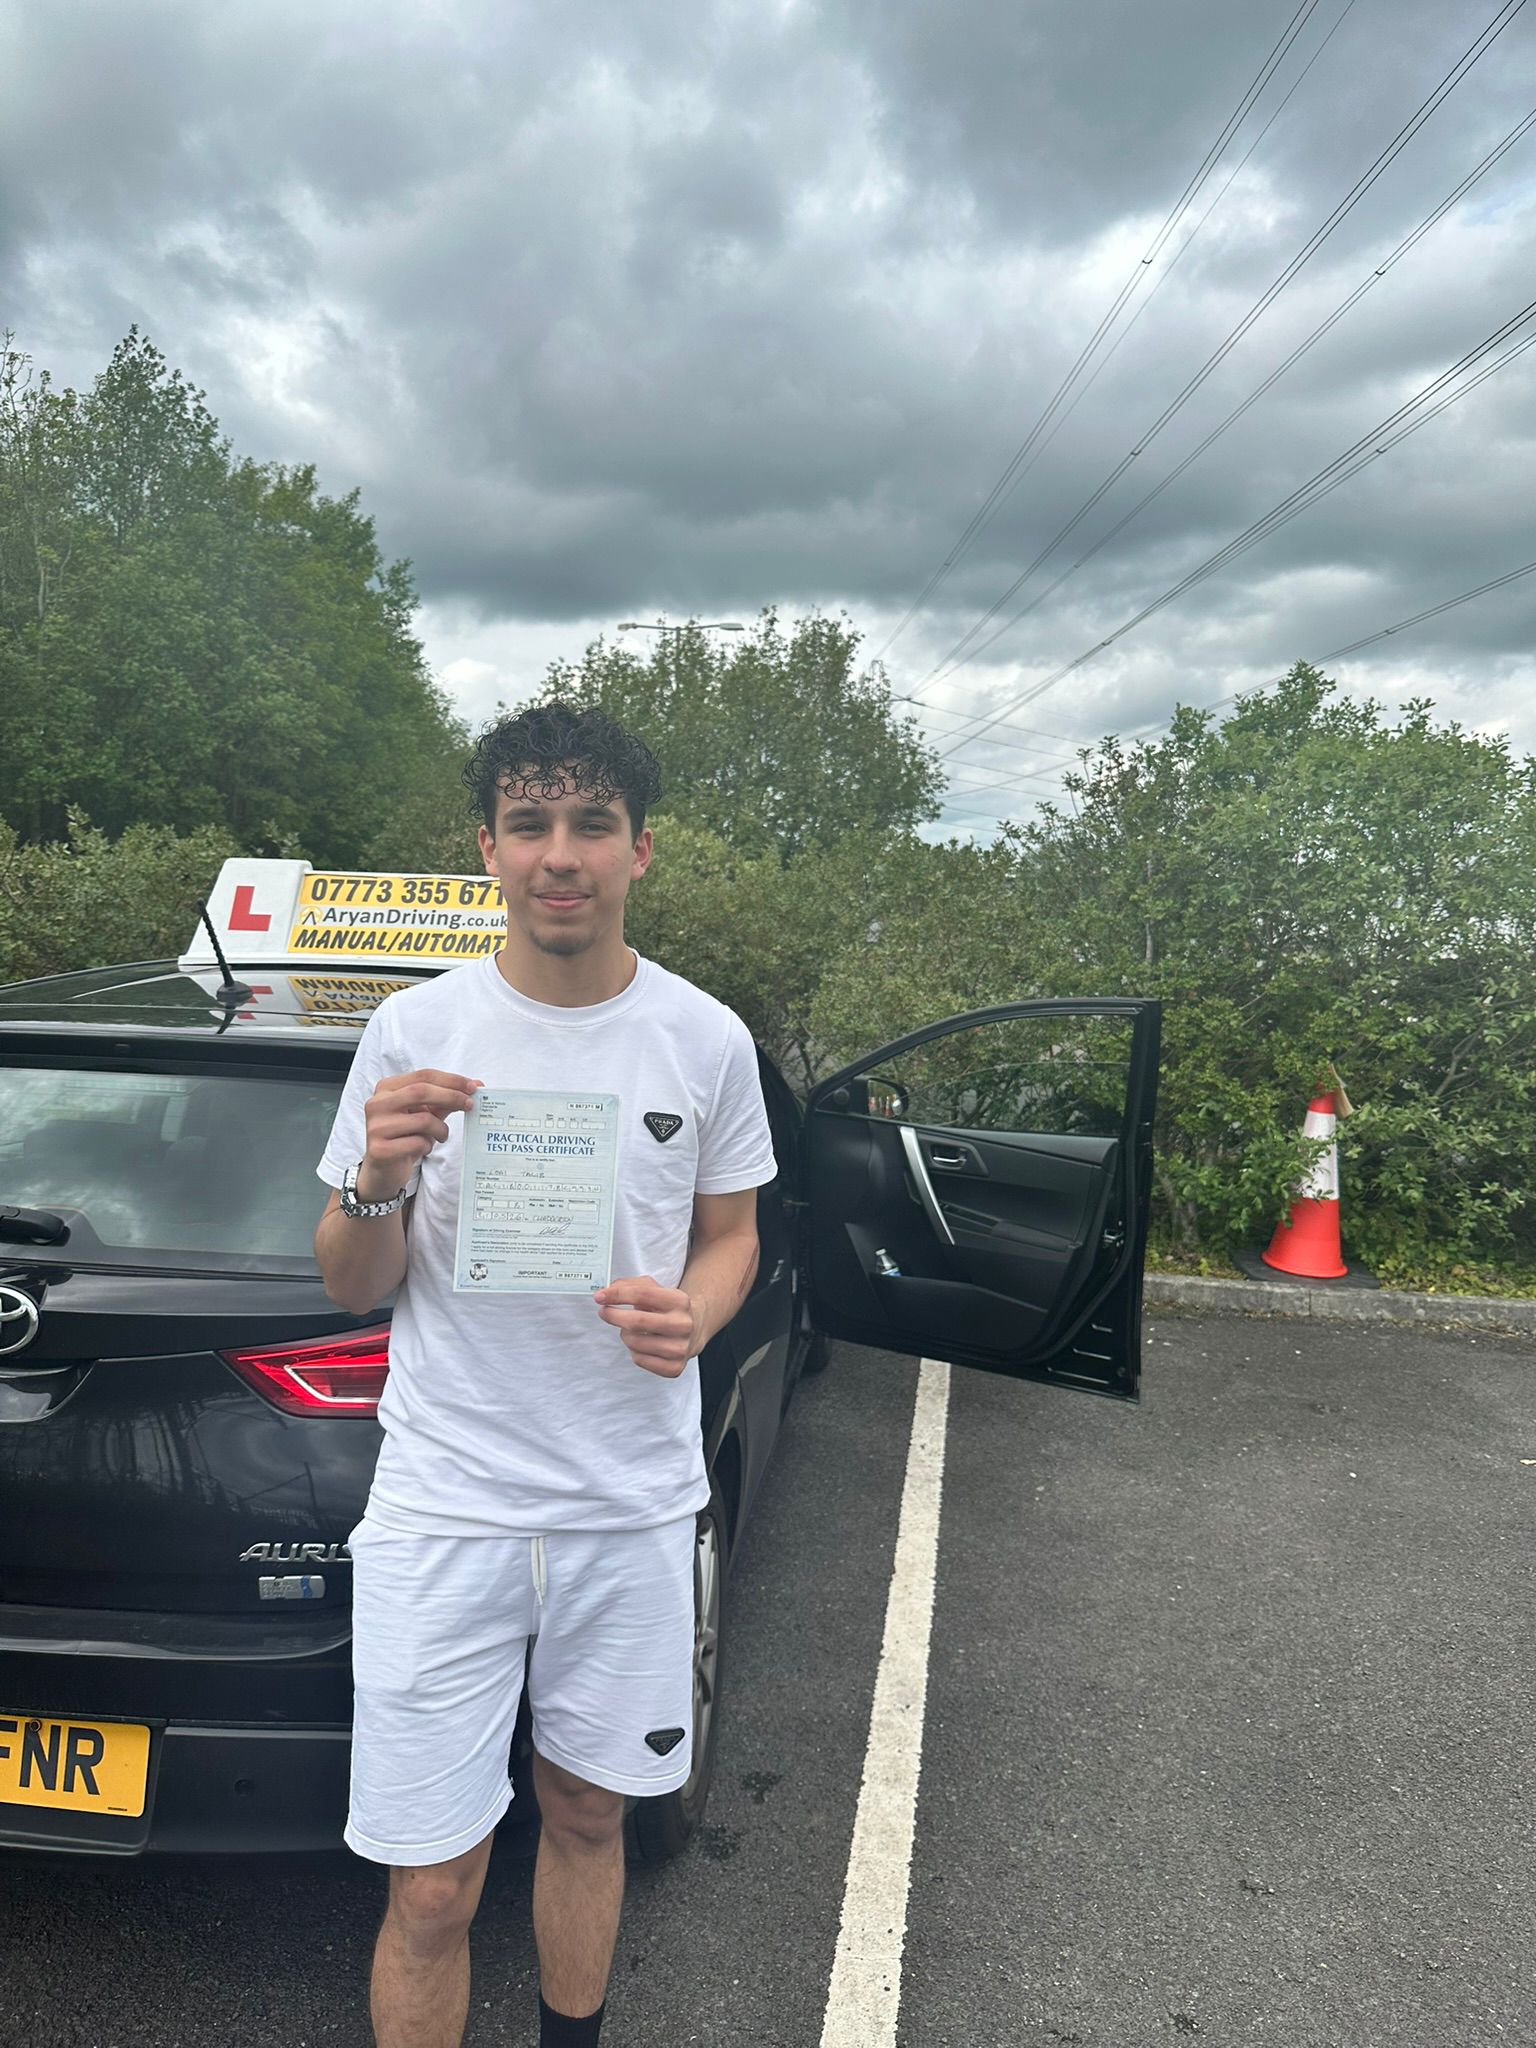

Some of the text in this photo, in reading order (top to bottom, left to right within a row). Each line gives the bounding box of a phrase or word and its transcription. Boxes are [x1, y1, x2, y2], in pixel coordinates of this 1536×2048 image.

[312, 878, 393, 903] 07773
[401, 881, 450, 905] 355
[227, 885, 272, 931] L
[322, 907, 508, 930] AryanDriving.co.uk
[487, 1132, 596, 1146] PRACTICAL DRIVING
[487, 1143, 595, 1156] TEST PASS CERTIFICATE
